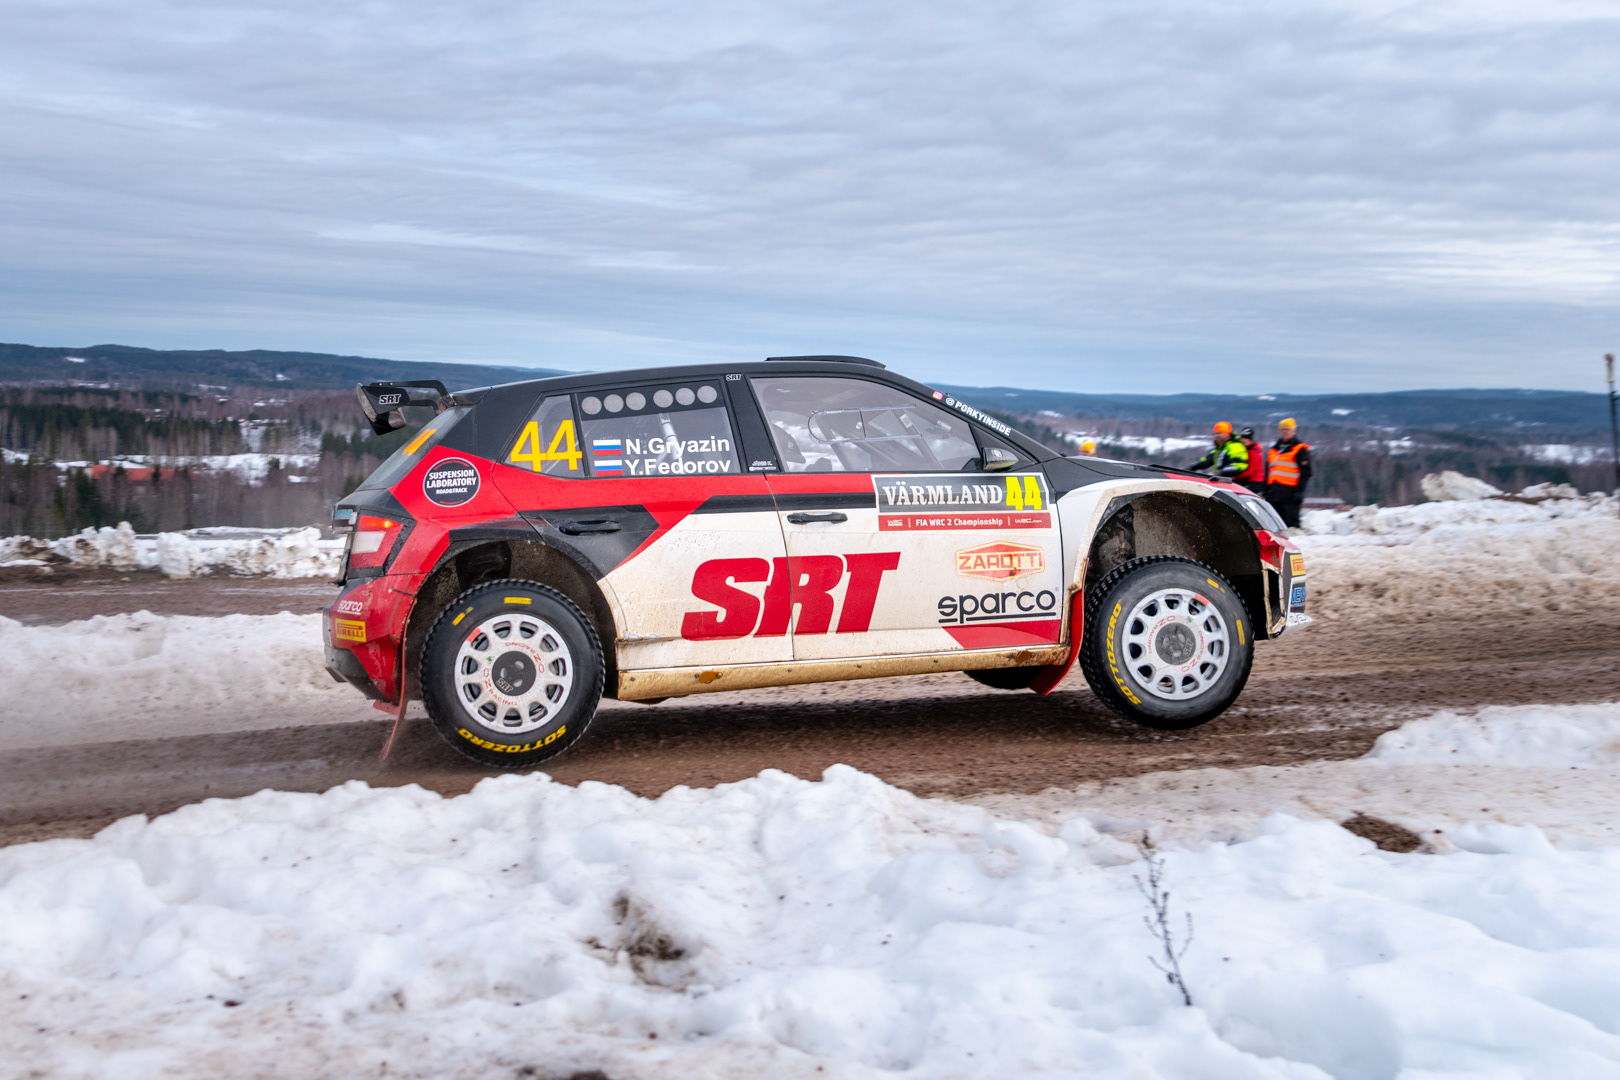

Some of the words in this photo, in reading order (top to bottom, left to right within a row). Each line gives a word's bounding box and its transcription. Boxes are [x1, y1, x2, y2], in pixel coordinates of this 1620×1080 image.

[379, 394, 401, 405] SRT
[510, 419, 582, 472] 44
[625, 436, 730, 459] N.Gryazin
[429, 469, 474, 480] SUSPENSION
[624, 459, 731, 475] Y.Fedorov
[426, 477, 477, 488] LABORATORY
[882, 481, 1003, 506] VÄRMLAND
[1005, 476, 1042, 510] 44
[929, 518, 945, 526] WRC
[947, 518, 952, 526] 2
[953, 517, 1003, 527] Championship
[681, 552, 901, 641] SRT
[338, 600, 363, 615] sparco
[938, 590, 1056, 624] sparco
[337, 622, 364, 638] PIRELLI
[1106, 602, 1142, 705] SOTTOZERO
[458, 725, 567, 753] SOTTOZERO
